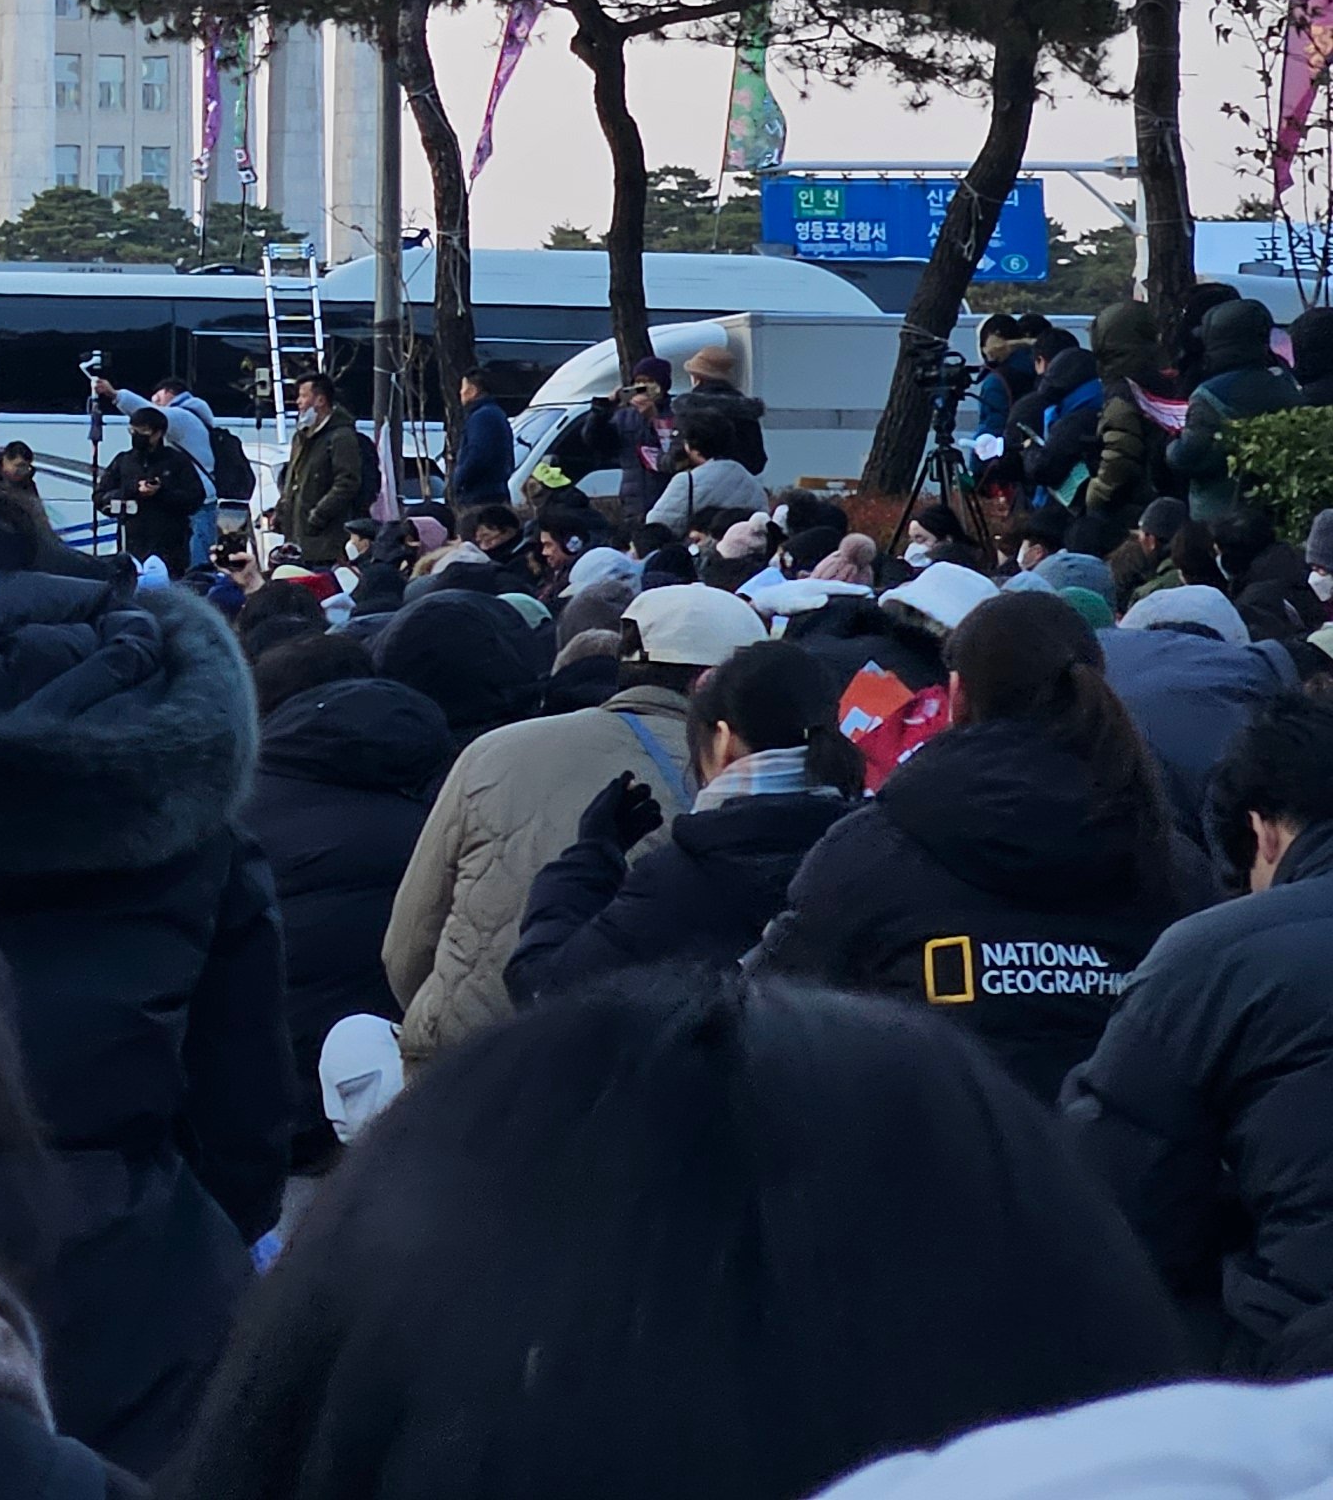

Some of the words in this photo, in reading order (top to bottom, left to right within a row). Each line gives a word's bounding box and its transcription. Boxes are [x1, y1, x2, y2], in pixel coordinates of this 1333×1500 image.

[795, 221, 887, 242] 영등포경찰서
[1009, 256, 1021, 270] 6
[981, 942, 1109, 968] NATIONAL
[981, 969, 1128, 995] GEOGRAPHI
